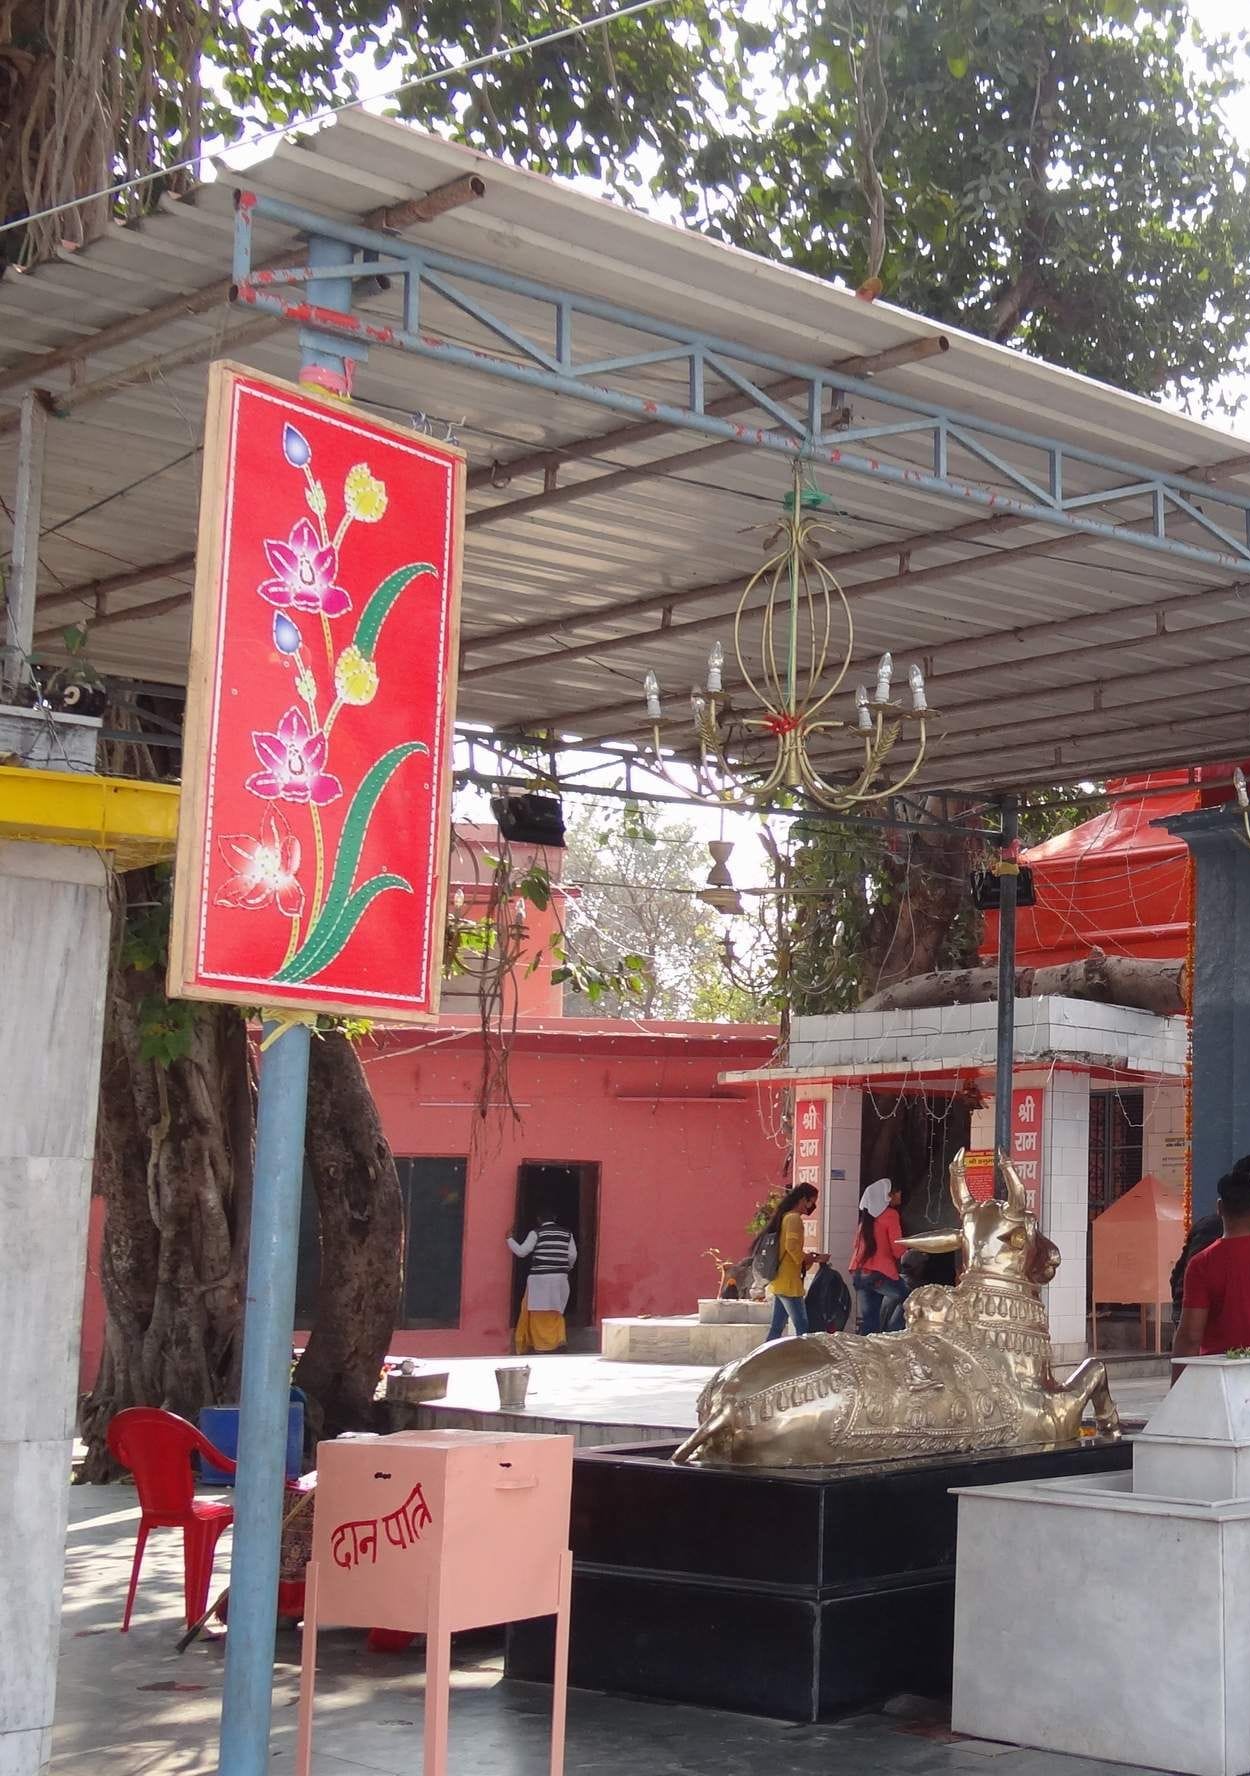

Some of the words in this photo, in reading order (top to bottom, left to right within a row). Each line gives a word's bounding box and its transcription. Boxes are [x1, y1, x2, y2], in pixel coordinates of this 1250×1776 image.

[803, 1104, 818, 1130] श्री
[1018, 1095, 1035, 1122] श्री
[800, 1139, 820, 1157] राम
[1014, 1132, 1038, 1152] राम
[799, 1166, 820, 1184] जय
[1014, 1160, 1038, 1179] जय
[331, 1519, 378, 1570] दान
